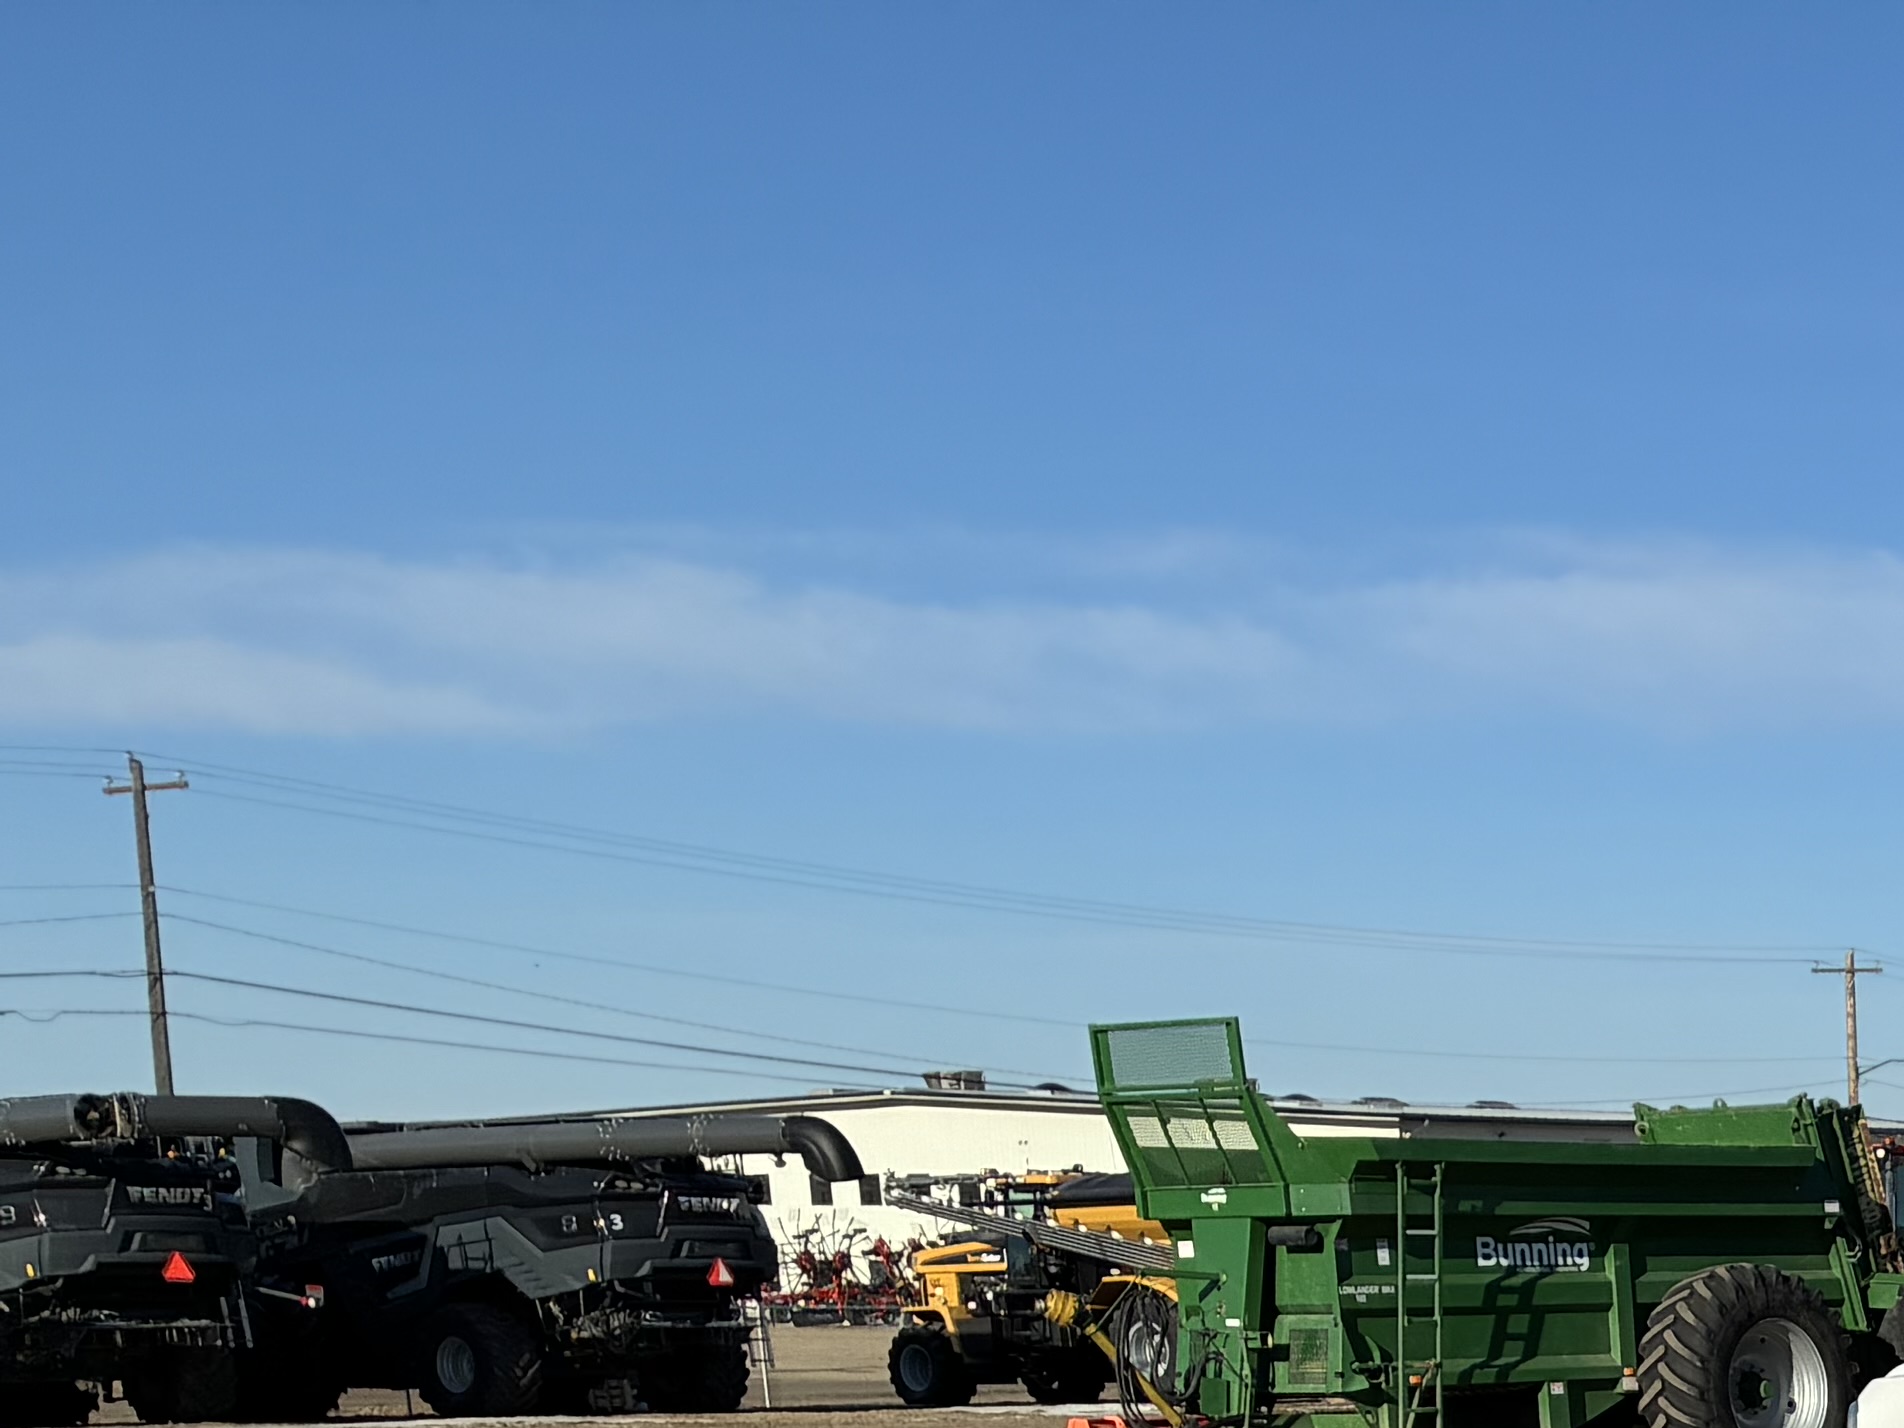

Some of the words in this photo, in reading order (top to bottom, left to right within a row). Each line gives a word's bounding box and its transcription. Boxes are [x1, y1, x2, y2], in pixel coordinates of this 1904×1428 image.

[126, 1186, 205, 1204] FENDT
[609, 1213, 624, 1231] 3
[1476, 1235, 1590, 1272] Bunning
